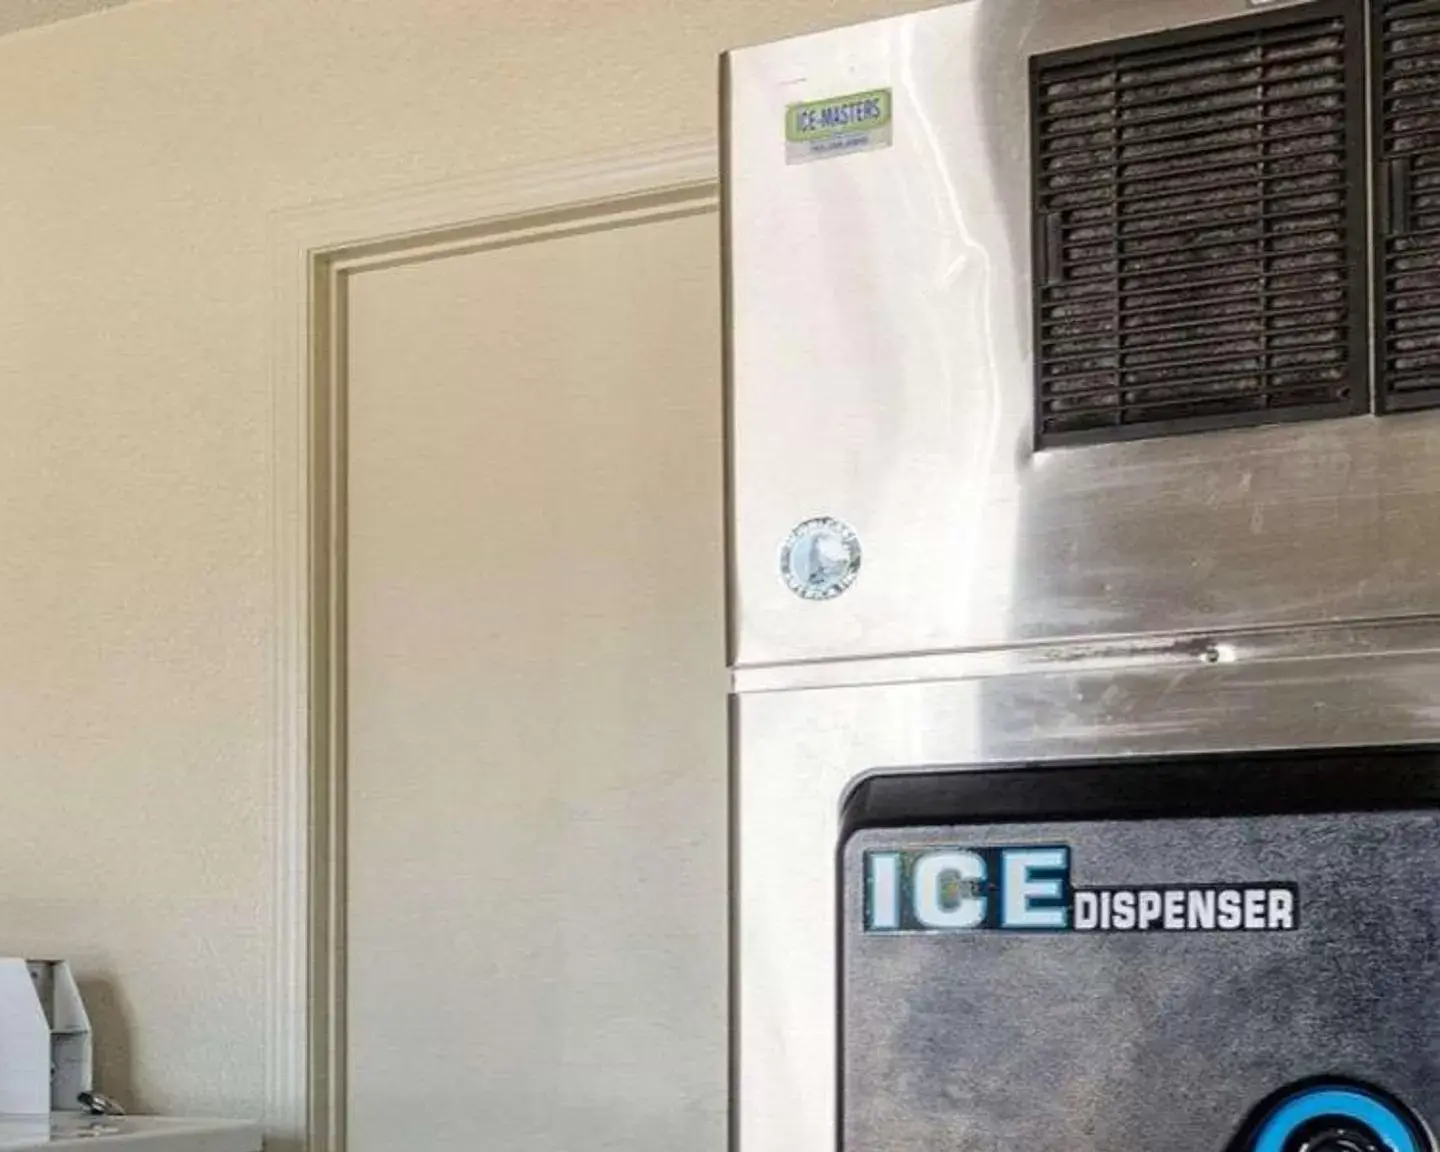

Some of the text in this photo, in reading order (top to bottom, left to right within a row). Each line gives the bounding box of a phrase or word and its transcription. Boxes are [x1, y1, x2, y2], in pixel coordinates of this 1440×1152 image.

[797, 98, 880, 132] ICE-MASTERS
[869, 848, 1295, 930] ICE DISPENSER
